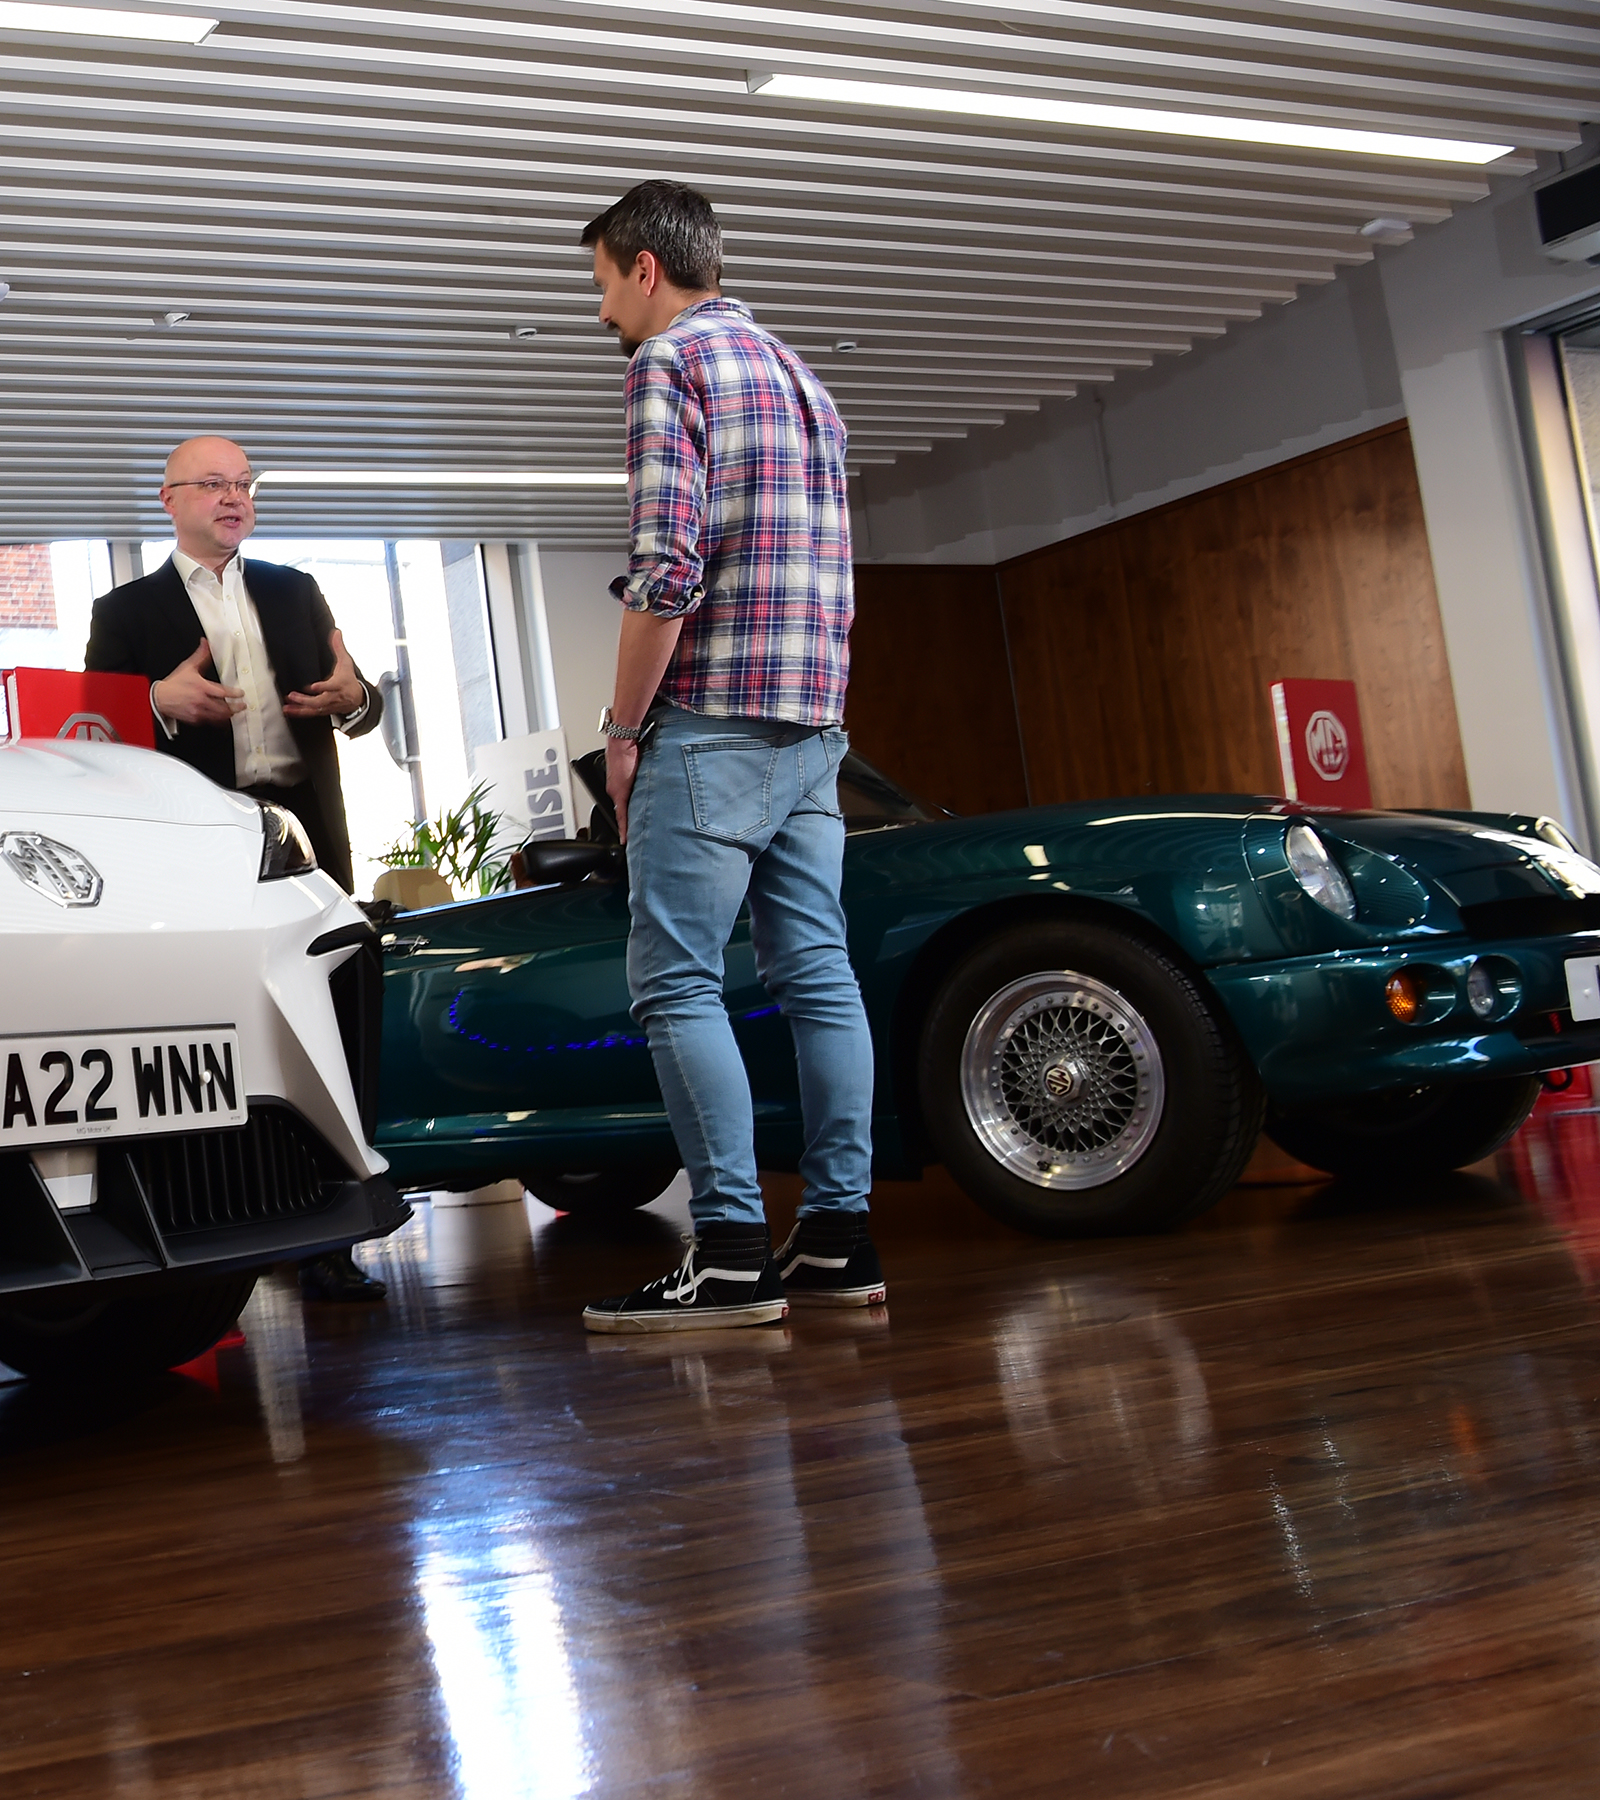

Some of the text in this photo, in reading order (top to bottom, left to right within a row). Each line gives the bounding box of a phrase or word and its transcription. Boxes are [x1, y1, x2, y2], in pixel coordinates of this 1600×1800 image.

[1307, 715, 1346, 776] MG
[1, 832, 100, 905] MG
[131, 1042, 238, 1118] WNN
[1047, 1069, 1071, 1095] MG
